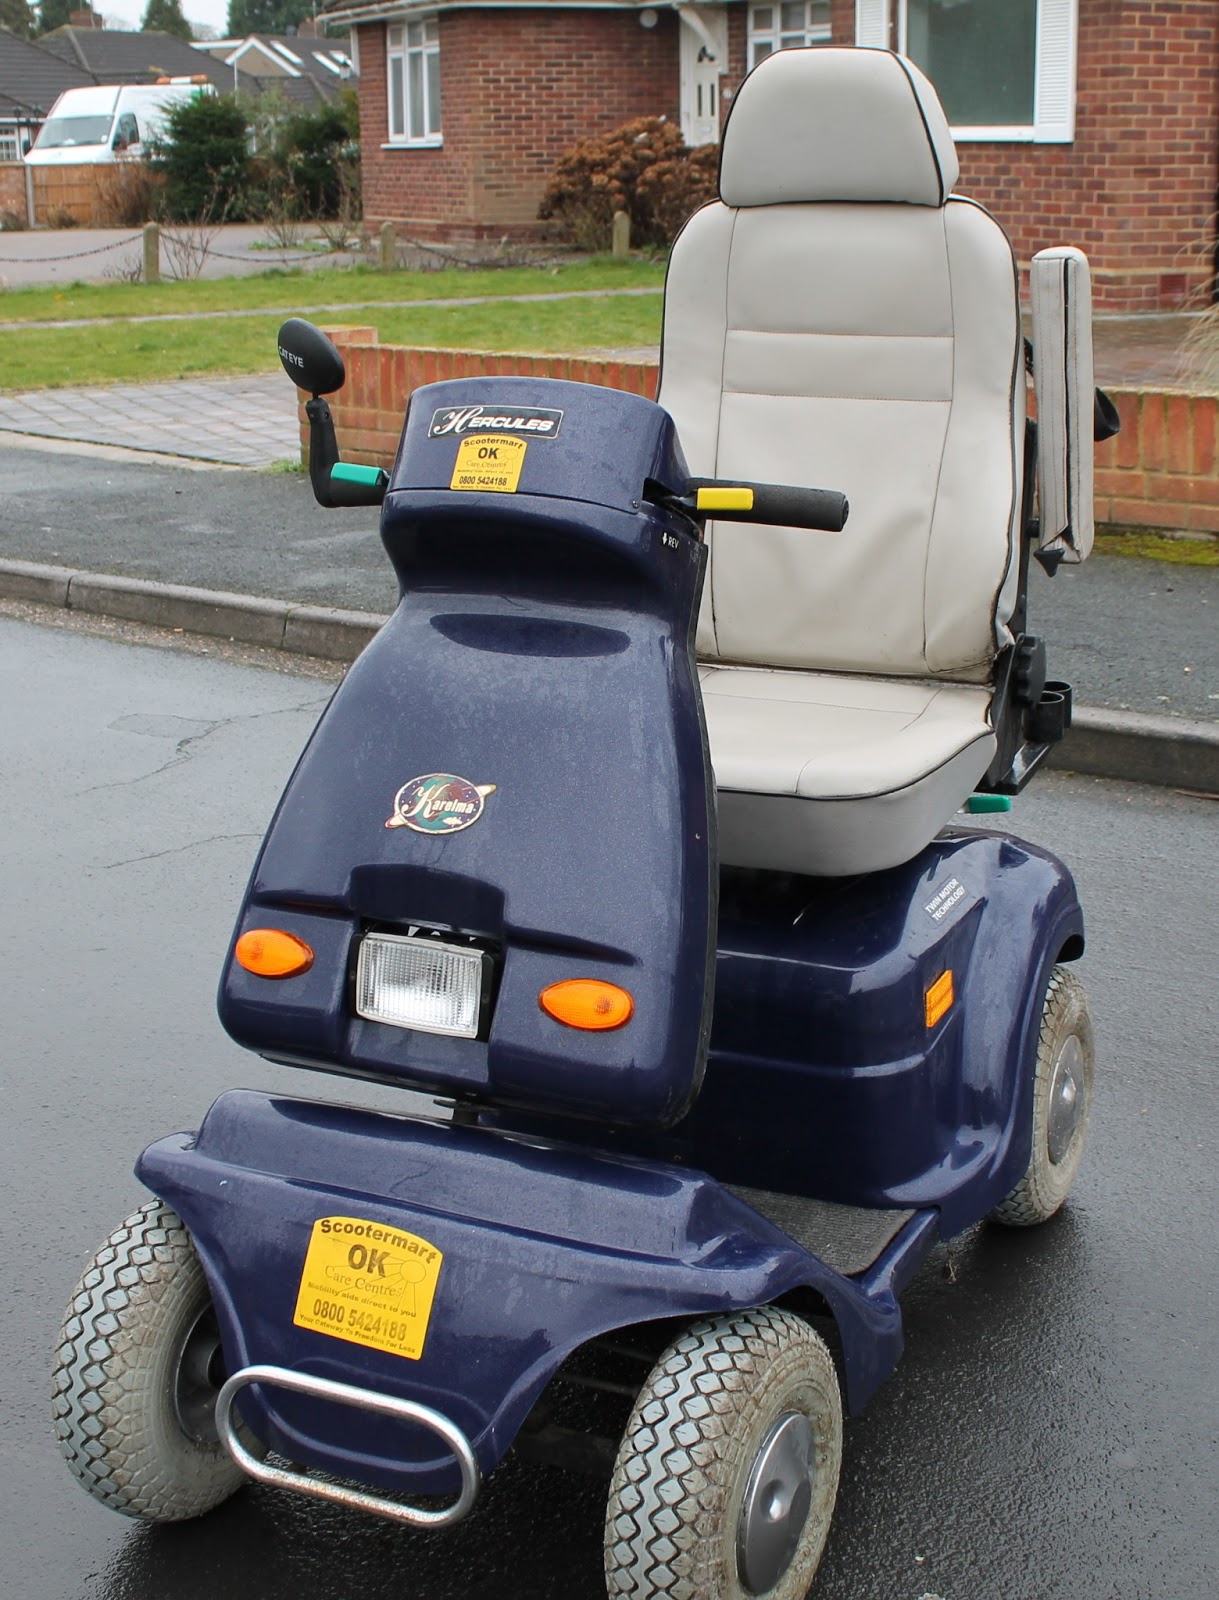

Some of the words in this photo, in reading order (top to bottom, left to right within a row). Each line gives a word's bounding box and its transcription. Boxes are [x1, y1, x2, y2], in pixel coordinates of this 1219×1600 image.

[433, 406, 555, 434] HERCULES
[464, 437, 523, 449] Scootermart
[478, 447, 500, 460] OK
[668, 536, 680, 549] REV
[925, 895, 942, 913] TWIN
[938, 878, 959, 900] MOTOR
[932, 885, 966, 921] TECHNOLOGY
[320, 1219, 436, 1264] Scootermart
[347, 1243, 392, 1278] OK
[325, 1265, 351, 1286] Care
[355, 1277, 402, 1297] Centres
[308, 1281, 340, 1296] Mobility
[341, 1292, 359, 1302] aids
[361, 1298, 387, 1310] direct
[389, 1305, 399, 1313] to
[400, 1309, 416, 1318] you
[313, 1298, 345, 1323] 0800
[348, 1309, 407, 1341] 5424188
